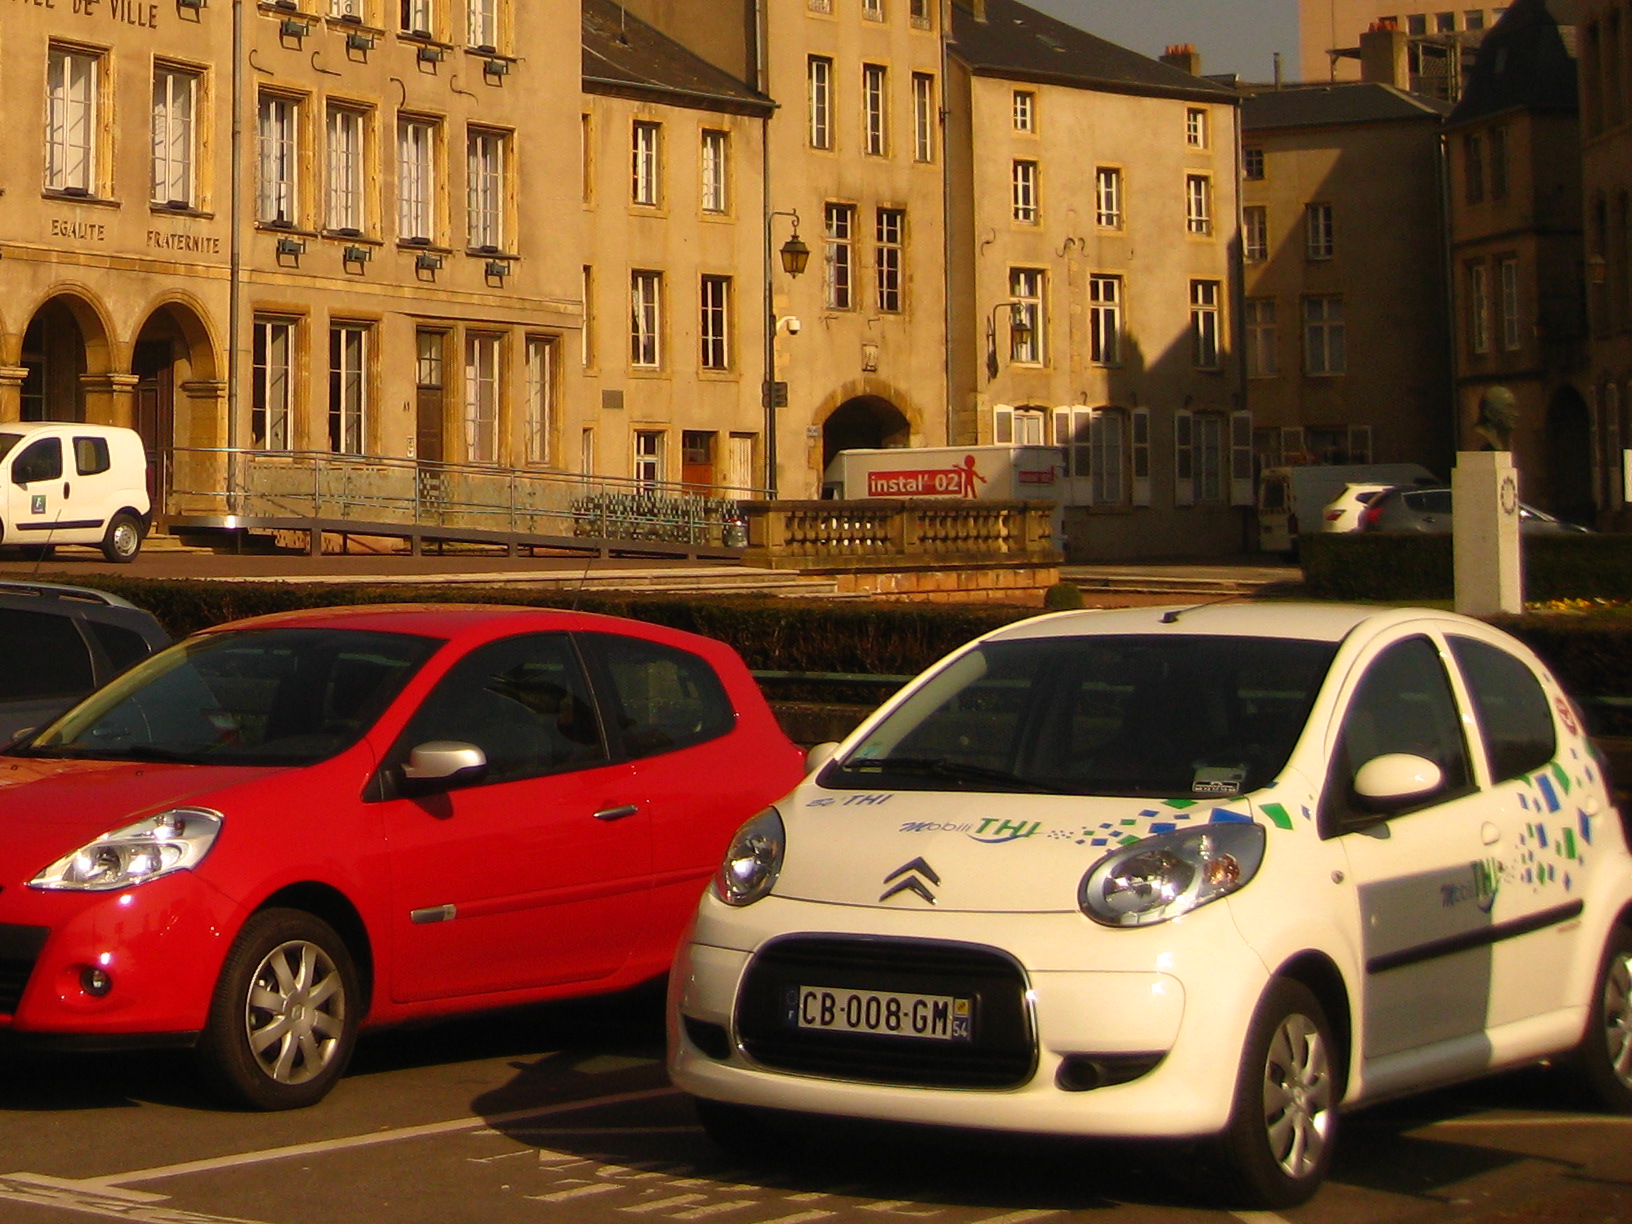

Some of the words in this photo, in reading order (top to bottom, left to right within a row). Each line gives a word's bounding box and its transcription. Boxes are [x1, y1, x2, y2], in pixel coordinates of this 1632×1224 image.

[51, 219, 106, 241] EGALITE
[146, 230, 221, 255] FRATERNITE
[934, 473, 960, 492] 02
[802, 990, 949, 1036] CB-008-GM
[952, 1020, 968, 1038] 54
